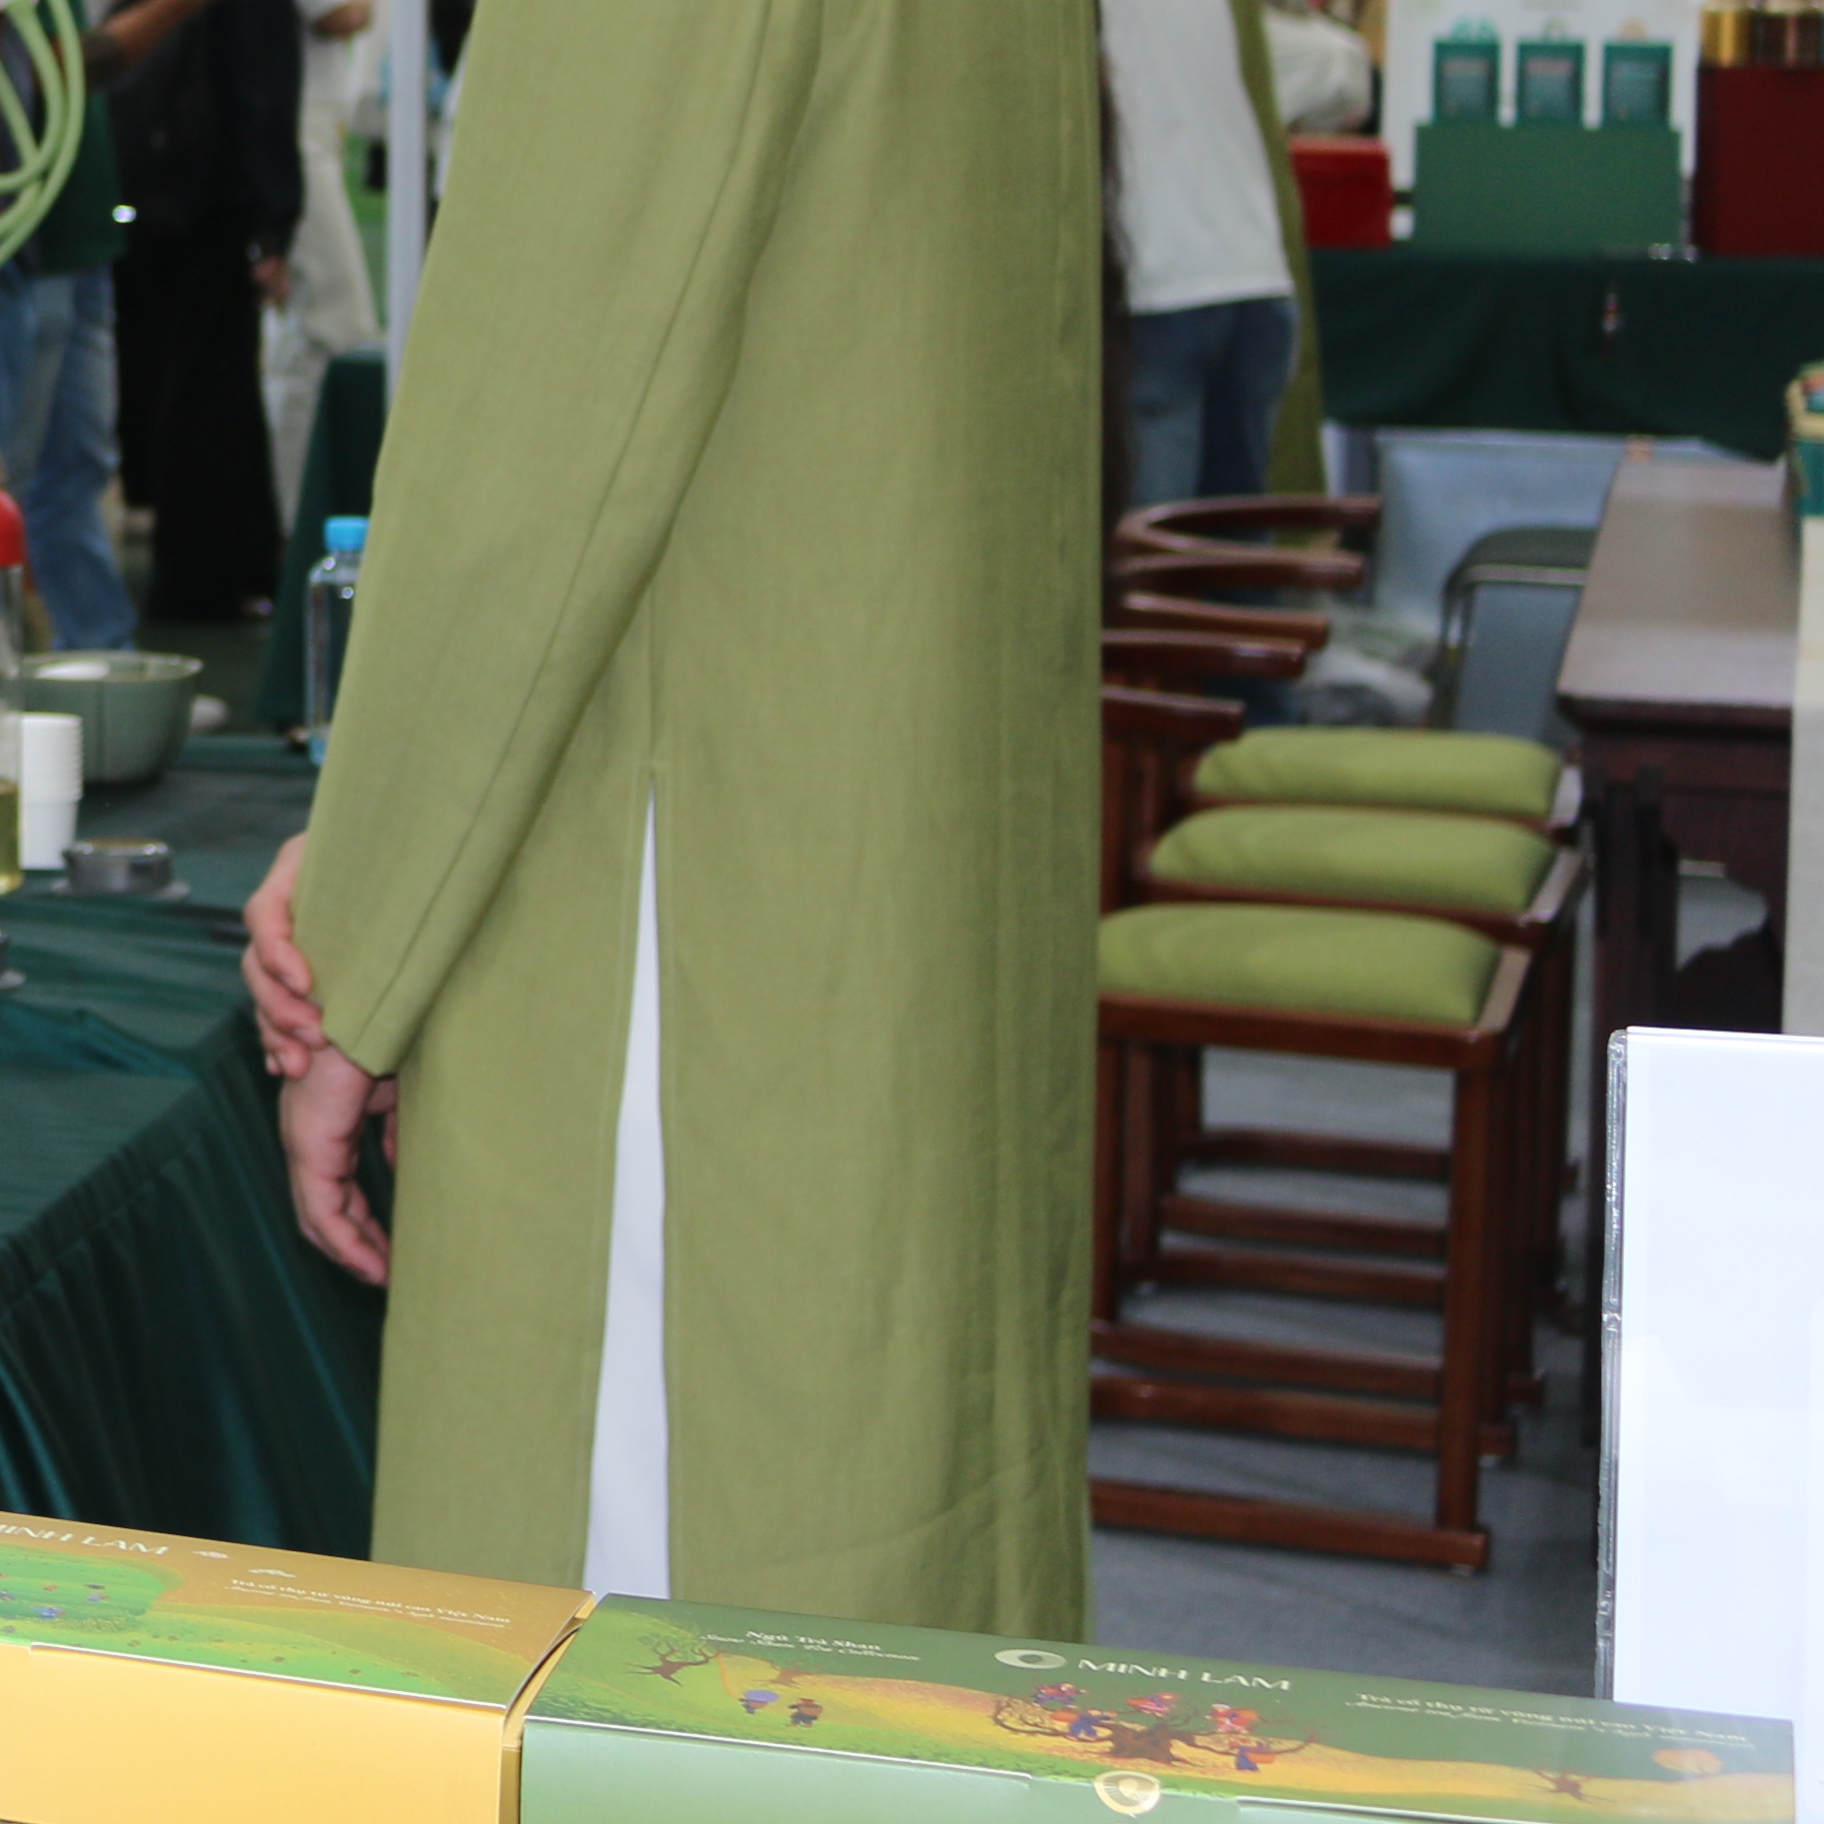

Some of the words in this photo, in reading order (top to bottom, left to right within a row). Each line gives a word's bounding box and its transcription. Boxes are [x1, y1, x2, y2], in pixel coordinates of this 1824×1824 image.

[82, 1535, 170, 1556] LAM
[1078, 1658, 1188, 1681] MINH
[1201, 1671, 1290, 1691] LAM
